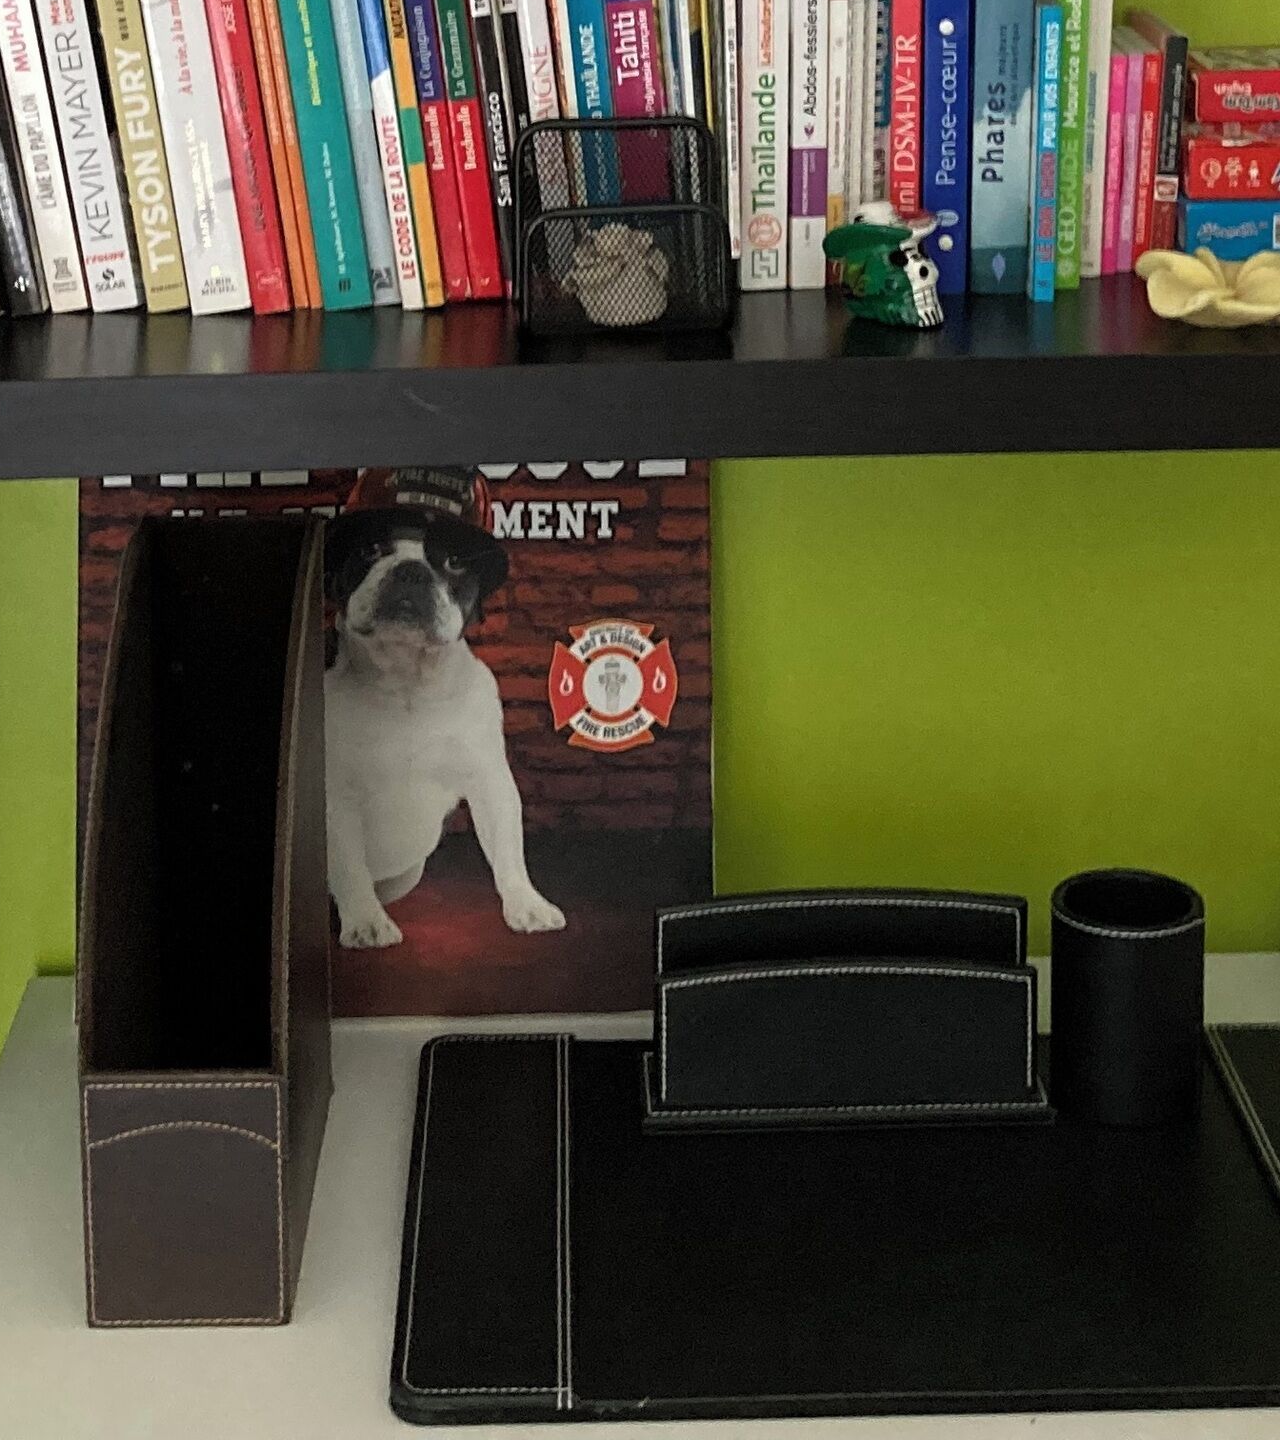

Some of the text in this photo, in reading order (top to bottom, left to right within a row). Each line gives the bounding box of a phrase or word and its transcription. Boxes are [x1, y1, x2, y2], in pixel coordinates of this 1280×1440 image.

[611, 9, 640, 85] Tahiti
[1062, 56, 1081, 128] Maurice
[1066, 33, 1081, 51] et
[52, 30, 114, 242] KEVIN MAYER
[486, 92, 513, 206] San Francisco
[751, 73, 776, 215] Thaïlande
[895, 34, 918, 172] DSM-IV-TR
[935, 39, 957, 186] Pense-cœur
[981, 81, 1007, 183] Phares
[1042, 112, 1058, 148] POUR
[1044, 84, 1058, 109] VOS
[118, 46, 175, 273] TYSON FURY
[381, 116, 416, 279] LE CODE DE LA ROUTE
[600, 635, 607, 644] &
